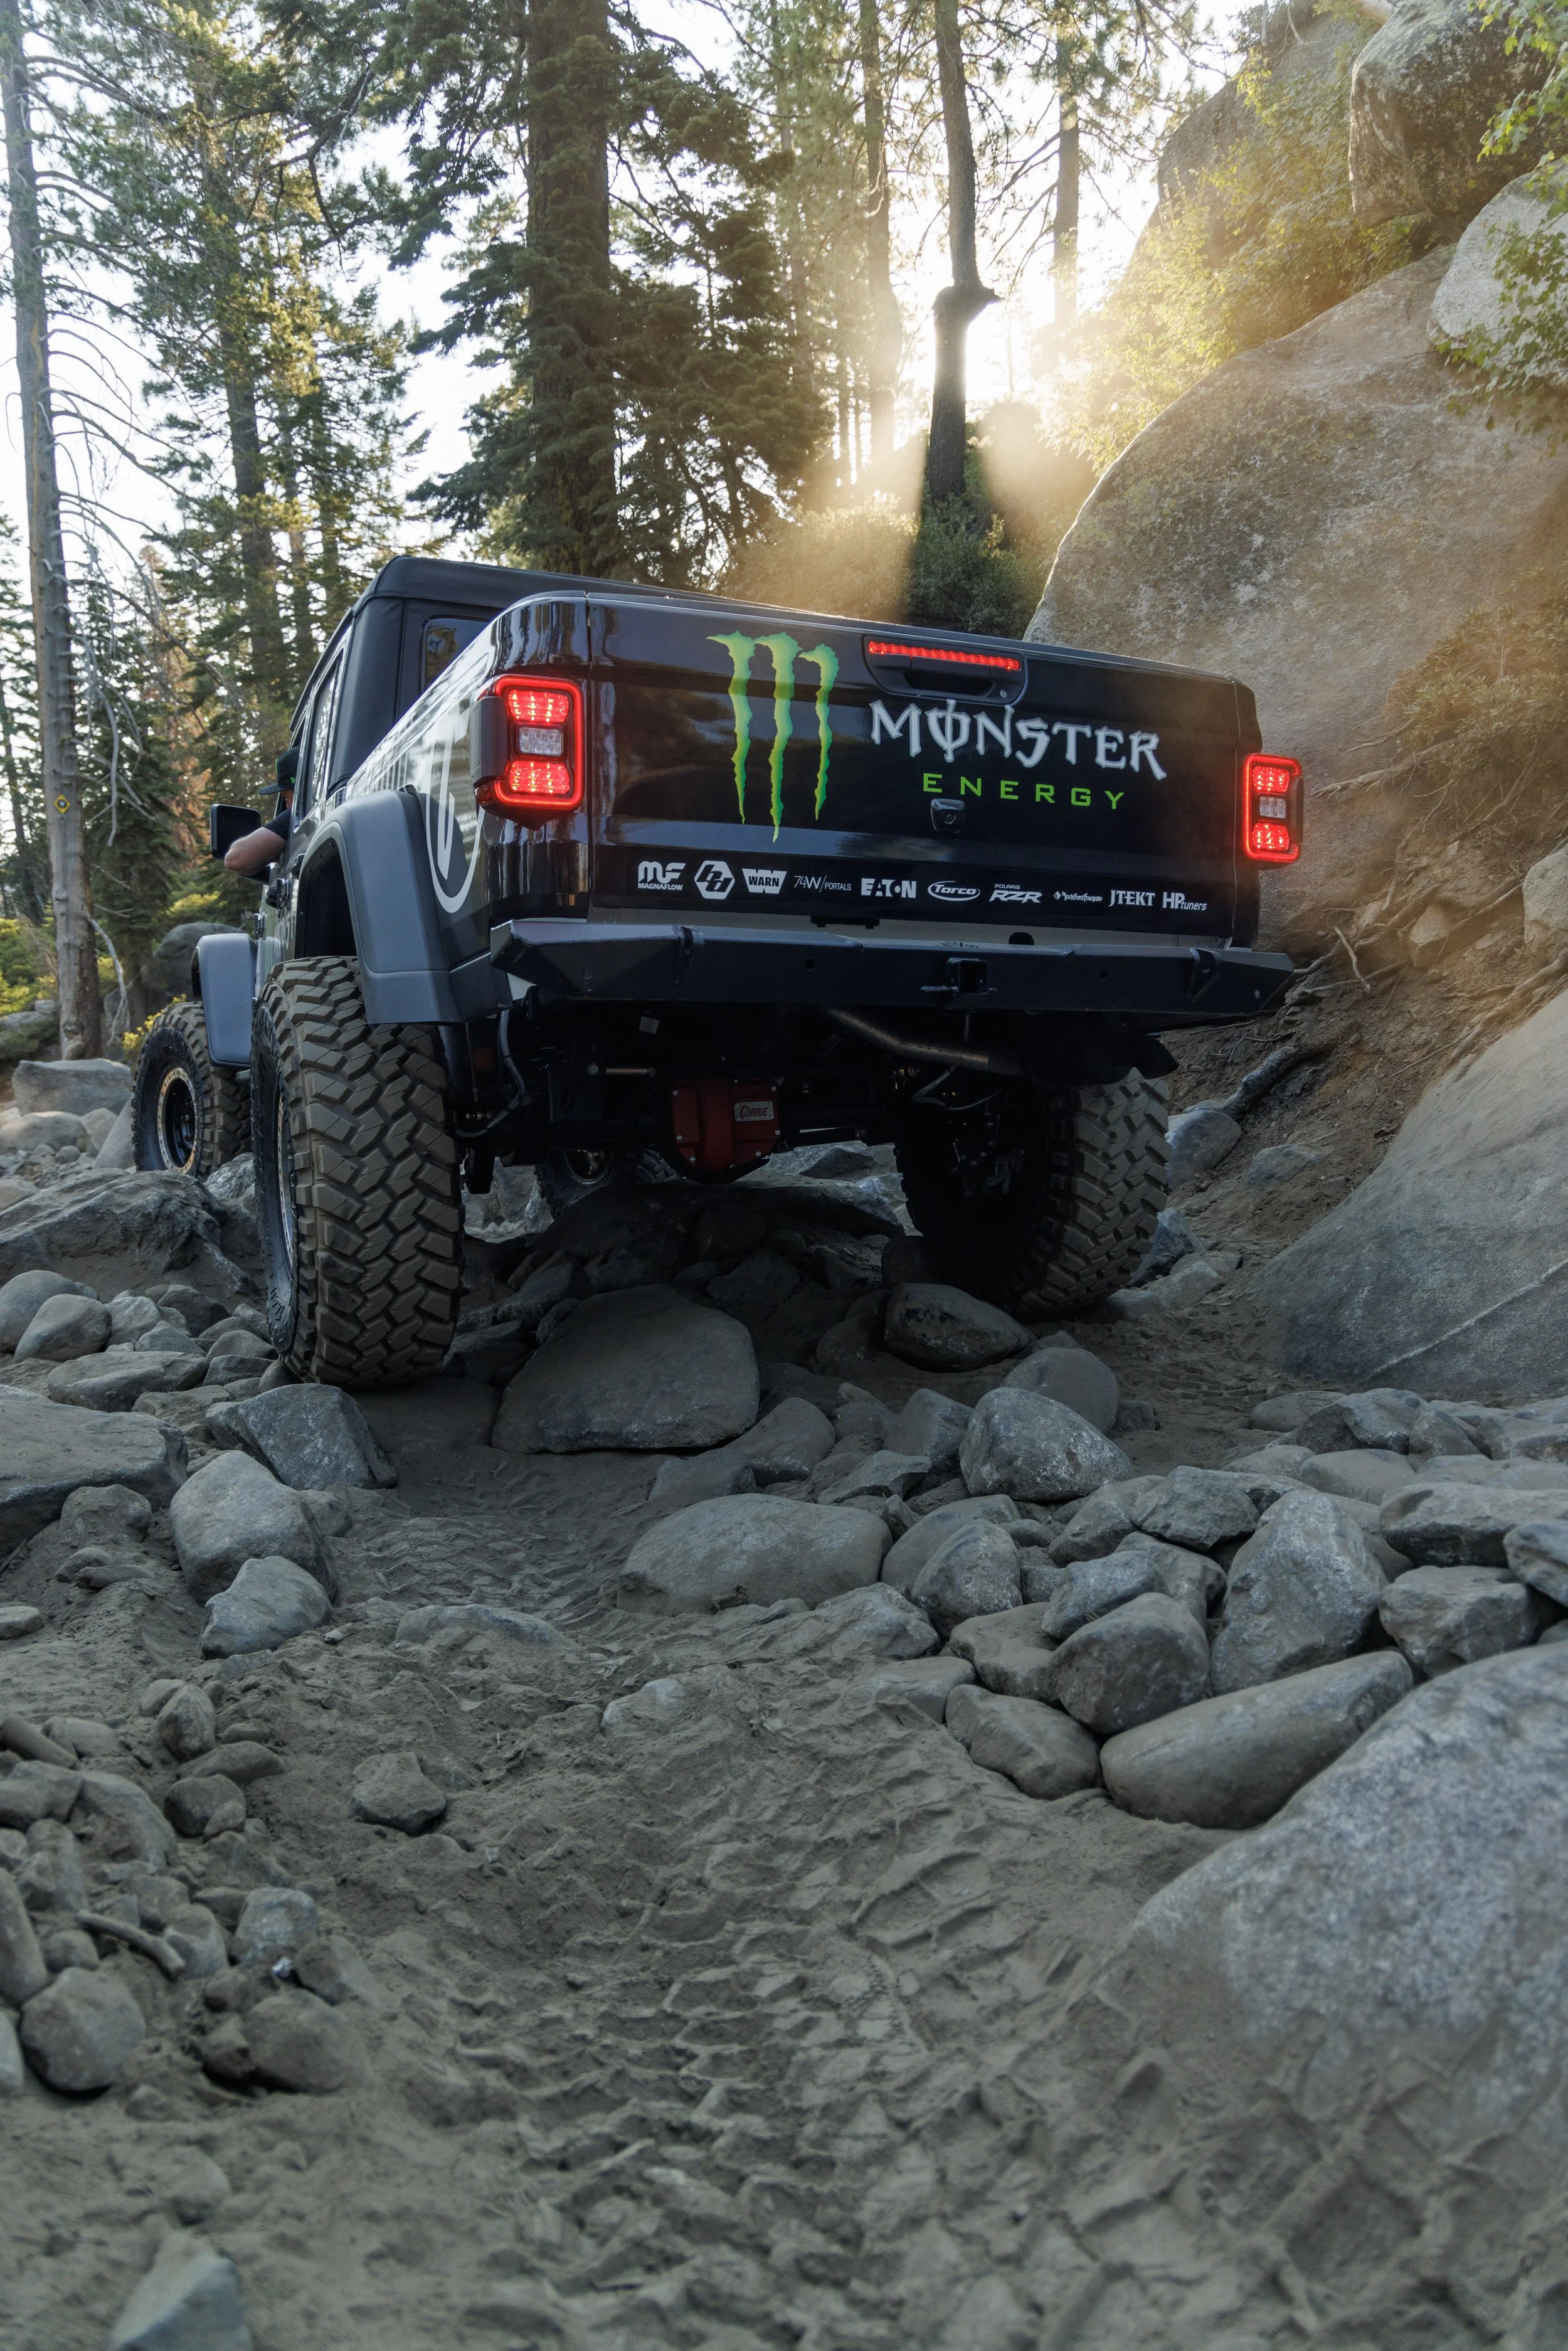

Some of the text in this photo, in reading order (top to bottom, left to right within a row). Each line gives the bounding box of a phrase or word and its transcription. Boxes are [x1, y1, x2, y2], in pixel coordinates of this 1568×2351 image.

[869, 699, 1167, 781] MONSTER
[923, 773, 1124, 809] ENERGY
[637, 882, 683, 891] MAGNAFLOW
[748, 876, 780, 887] WARN
[861, 878, 917, 898] EATON
[934, 884, 977, 895] Torco
[988, 889, 1043, 903] RZR
[1108, 889, 1155, 907] JTEKT
[740, 1105, 769, 1119] CURRIE
